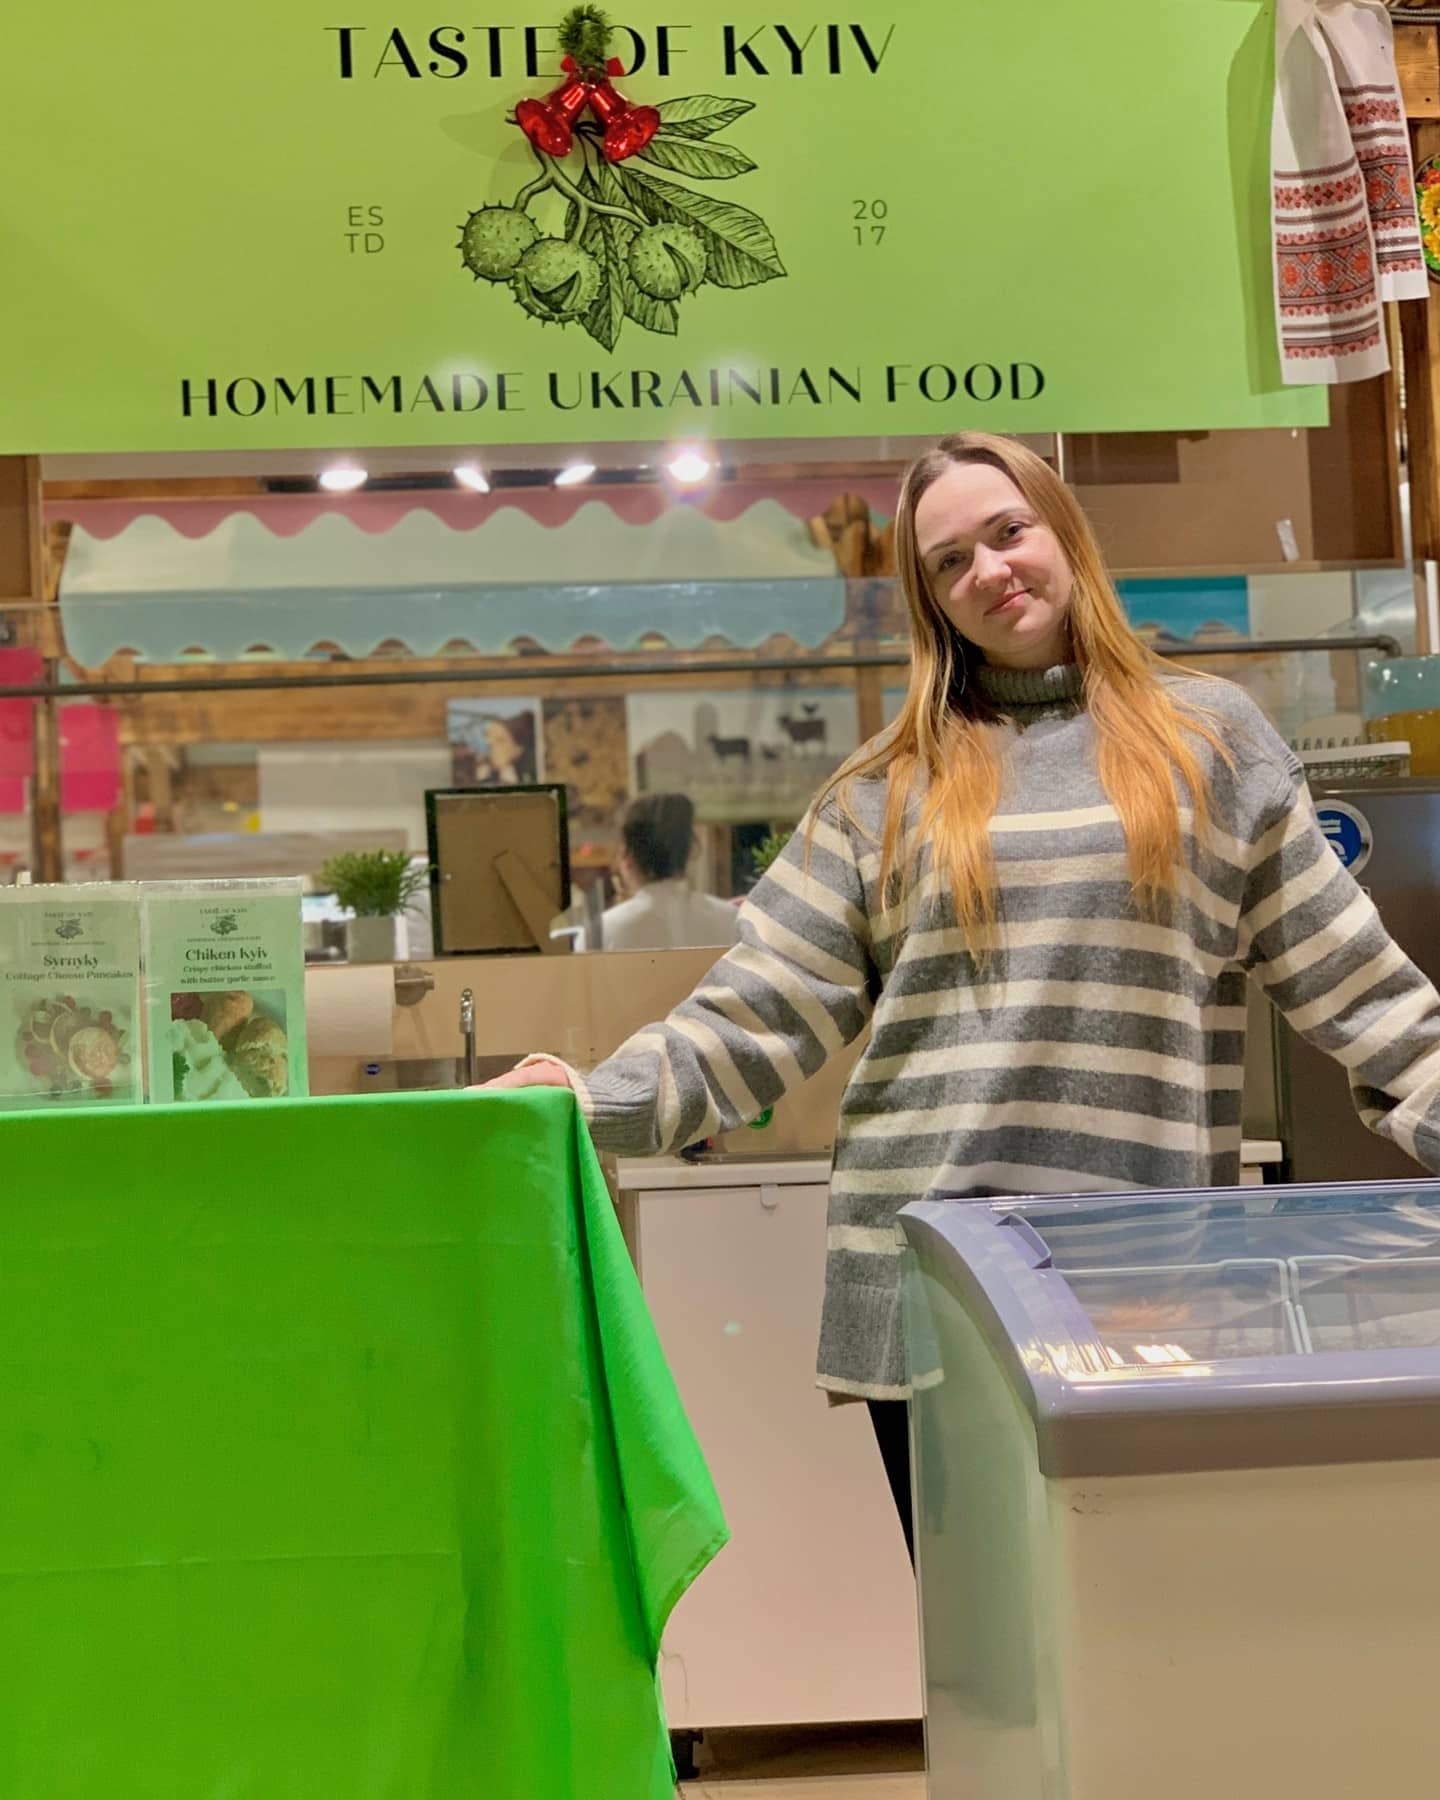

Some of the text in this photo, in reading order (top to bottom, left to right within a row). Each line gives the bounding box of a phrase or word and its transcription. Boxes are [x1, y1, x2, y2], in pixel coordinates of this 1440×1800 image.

[323, 23, 895, 79] TASTE OF KYIV
[348, 206, 384, 227] ES
[852, 199, 888, 220] 20
[343, 232, 385, 254] TD
[852, 225, 886, 246] 17
[181, 362, 1045, 417] HOMEMADE UKRAINIAN FOOD
[185, 946, 268, 962] Chiken Kyiv
